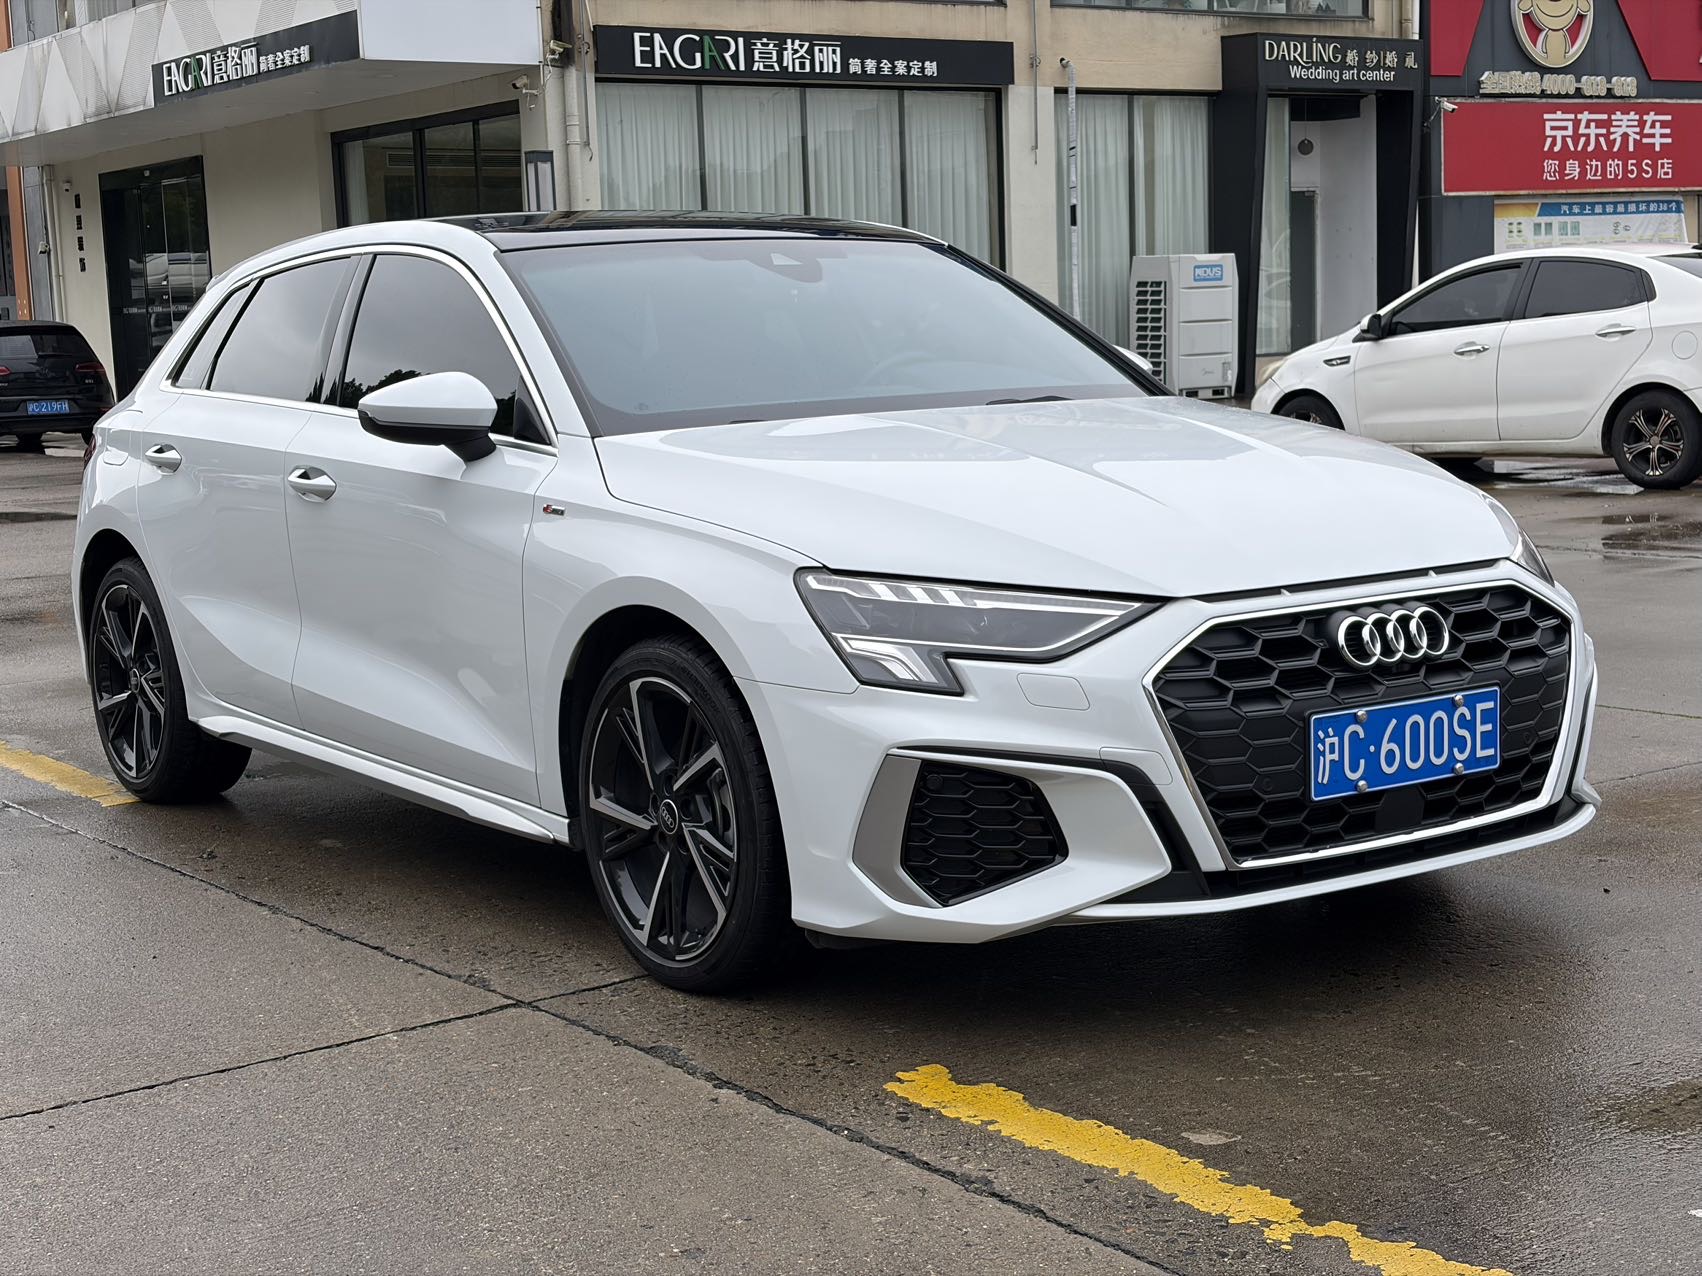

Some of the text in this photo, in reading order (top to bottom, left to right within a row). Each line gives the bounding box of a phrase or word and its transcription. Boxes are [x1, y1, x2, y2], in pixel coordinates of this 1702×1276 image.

[162, 52, 212, 96] EAGARI
[212, 41, 258, 84] 意格丽
[632, 31, 938, 77] EAGARI 意格丽 简奢全案定制
[1289, 65, 1395, 83] Wedding art center
[1543, 111, 1673, 152] 京东养车
[1543, 158, 1673, 181] 您身边的5S店
